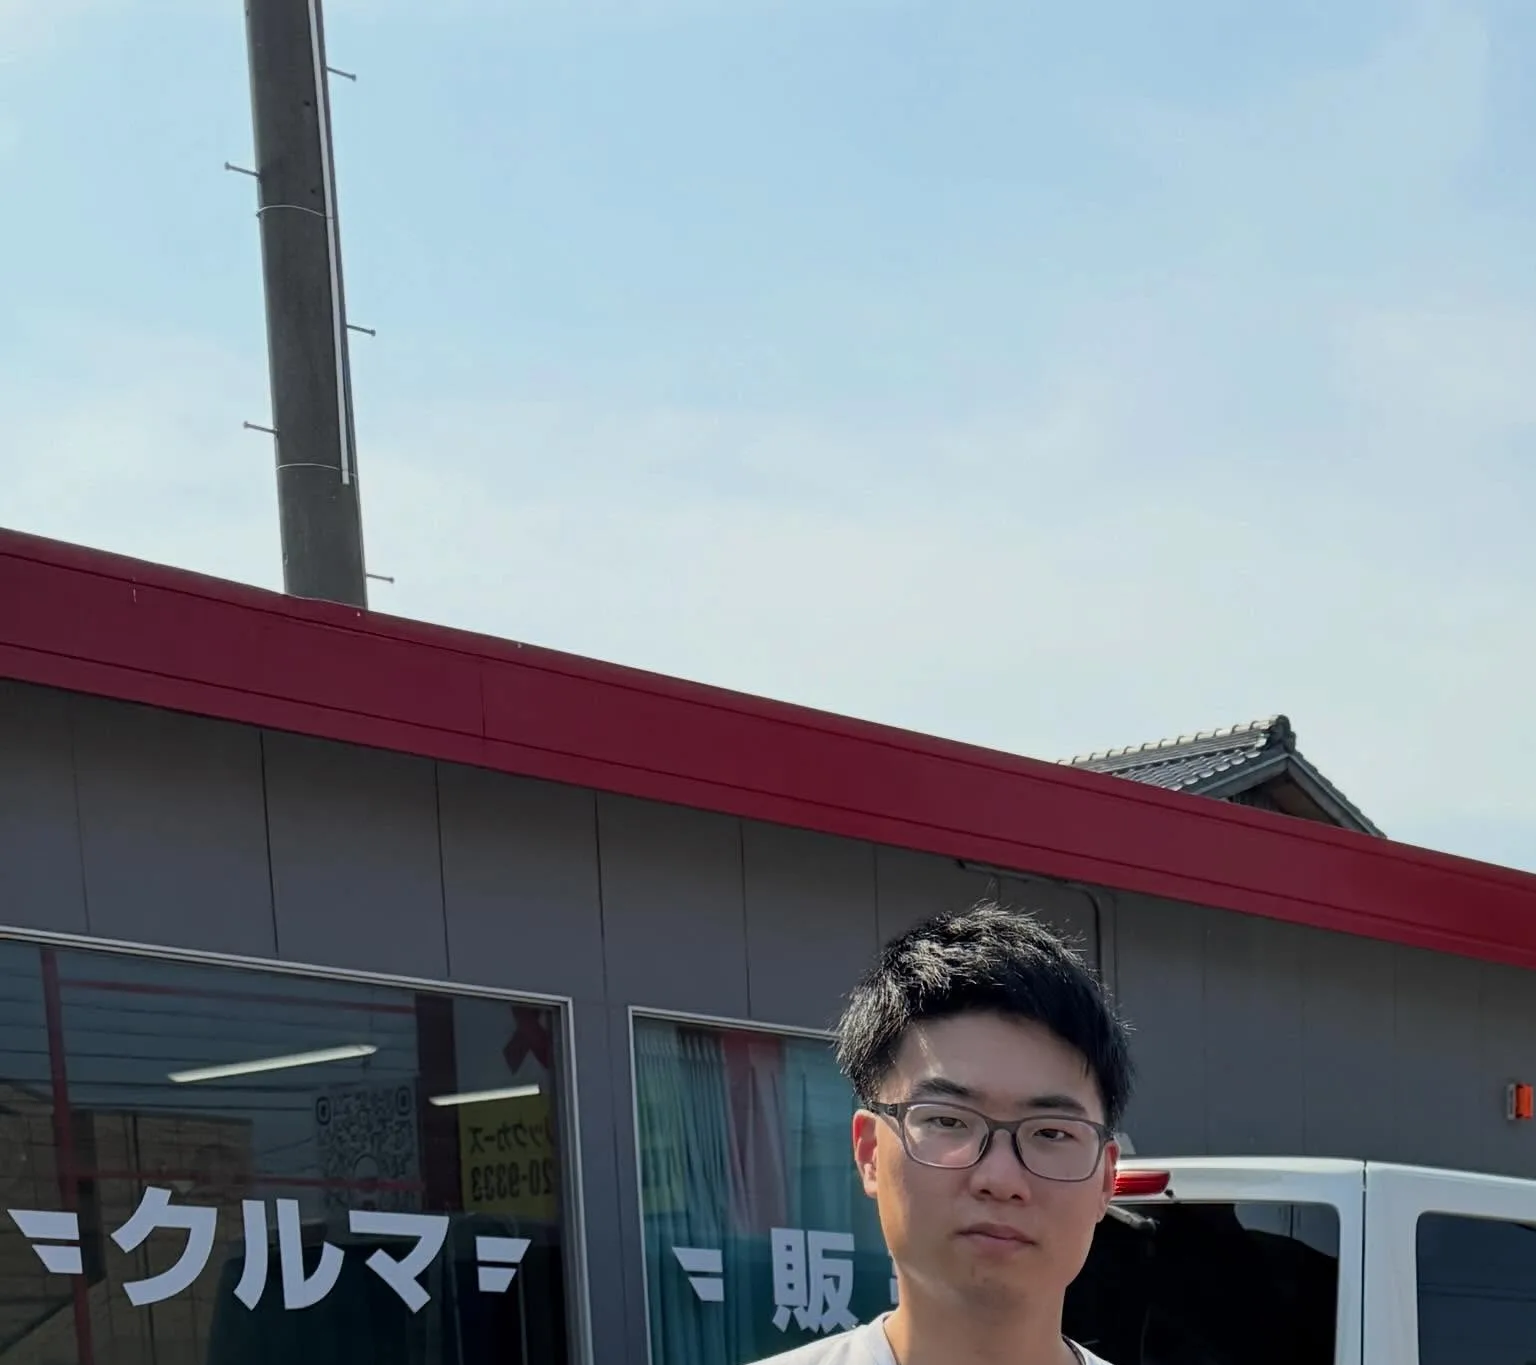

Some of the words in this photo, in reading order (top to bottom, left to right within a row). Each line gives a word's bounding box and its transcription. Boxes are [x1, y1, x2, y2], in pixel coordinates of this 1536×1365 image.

[111, 1186, 450, 1313] クルマ
[771, 1227, 900, 1332] 販
